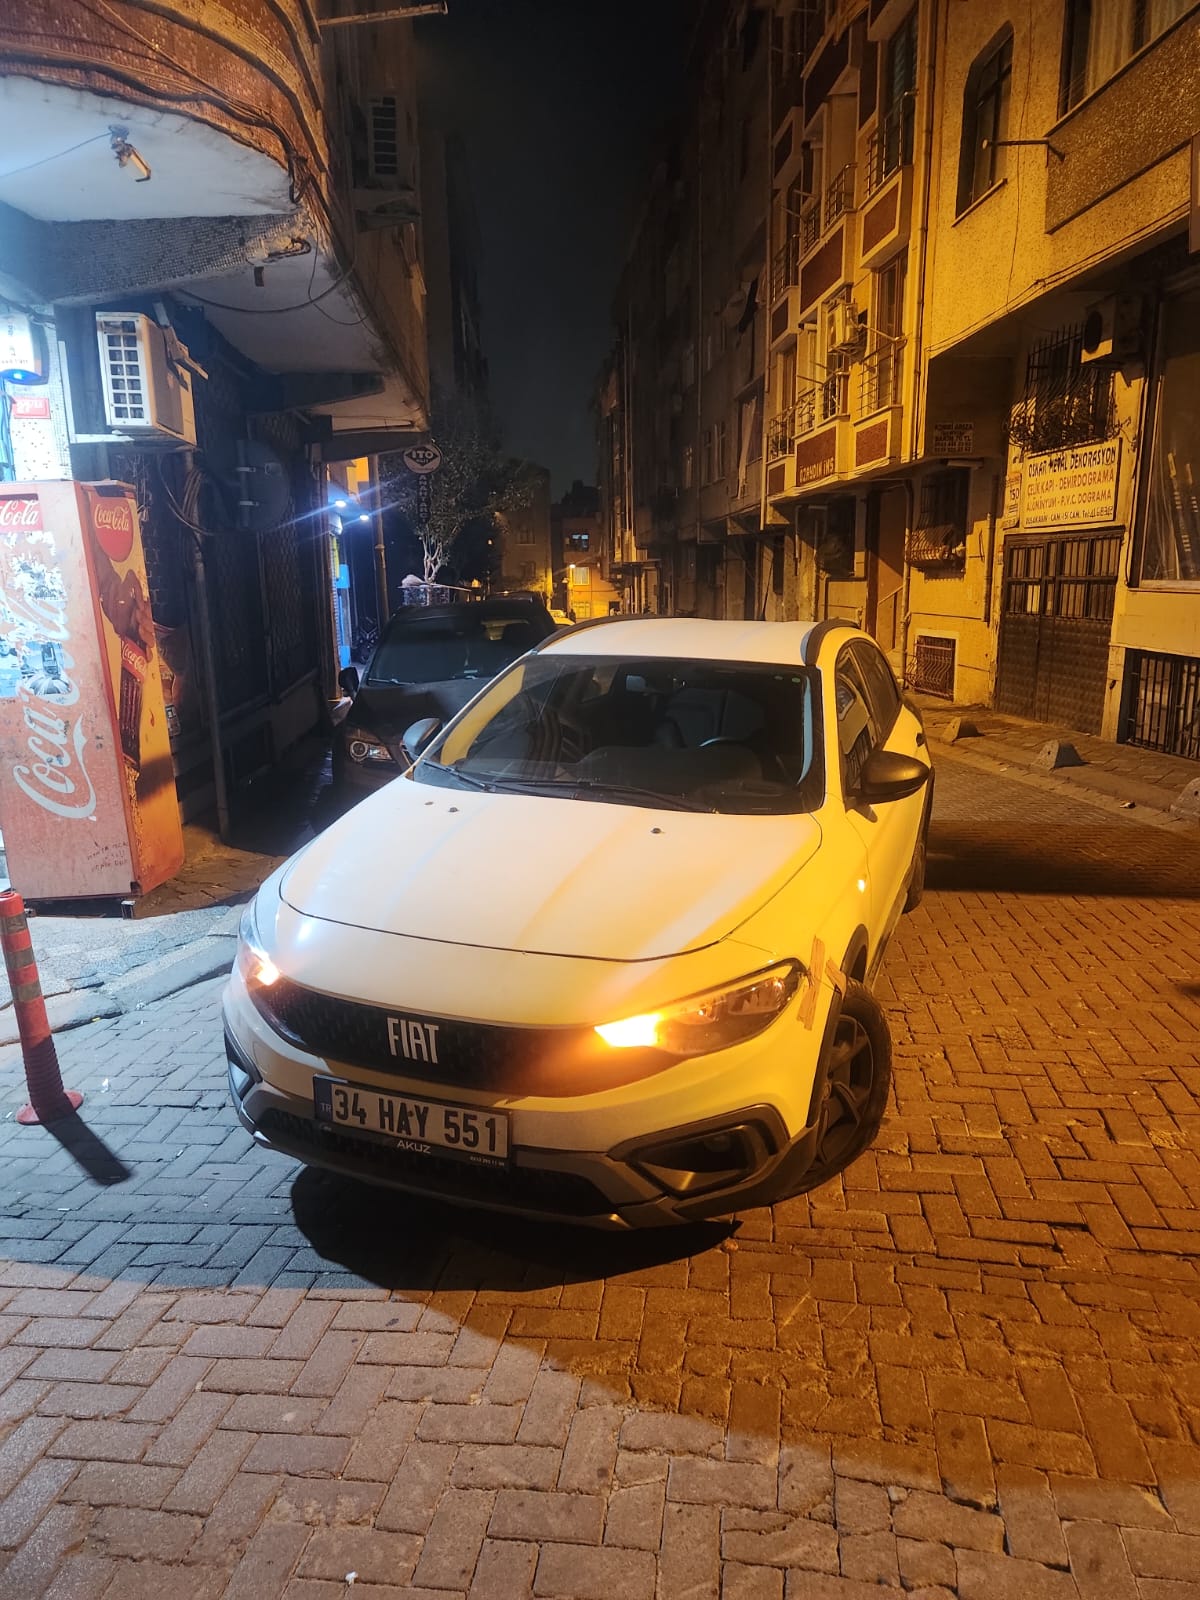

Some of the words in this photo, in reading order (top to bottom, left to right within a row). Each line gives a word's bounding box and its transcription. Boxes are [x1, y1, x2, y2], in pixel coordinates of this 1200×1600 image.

[1070, 447, 1116, 469] DEKORASYON
[94, 503, 130, 532] Coca-Cola
[387, 1017, 440, 1064] FIAT
[334, 1089, 367, 1125] 34
[378, 1098, 429, 1138] HAY
[444, 1110, 496, 1152] 551
[397, 1140, 431, 1154] AKUZ
